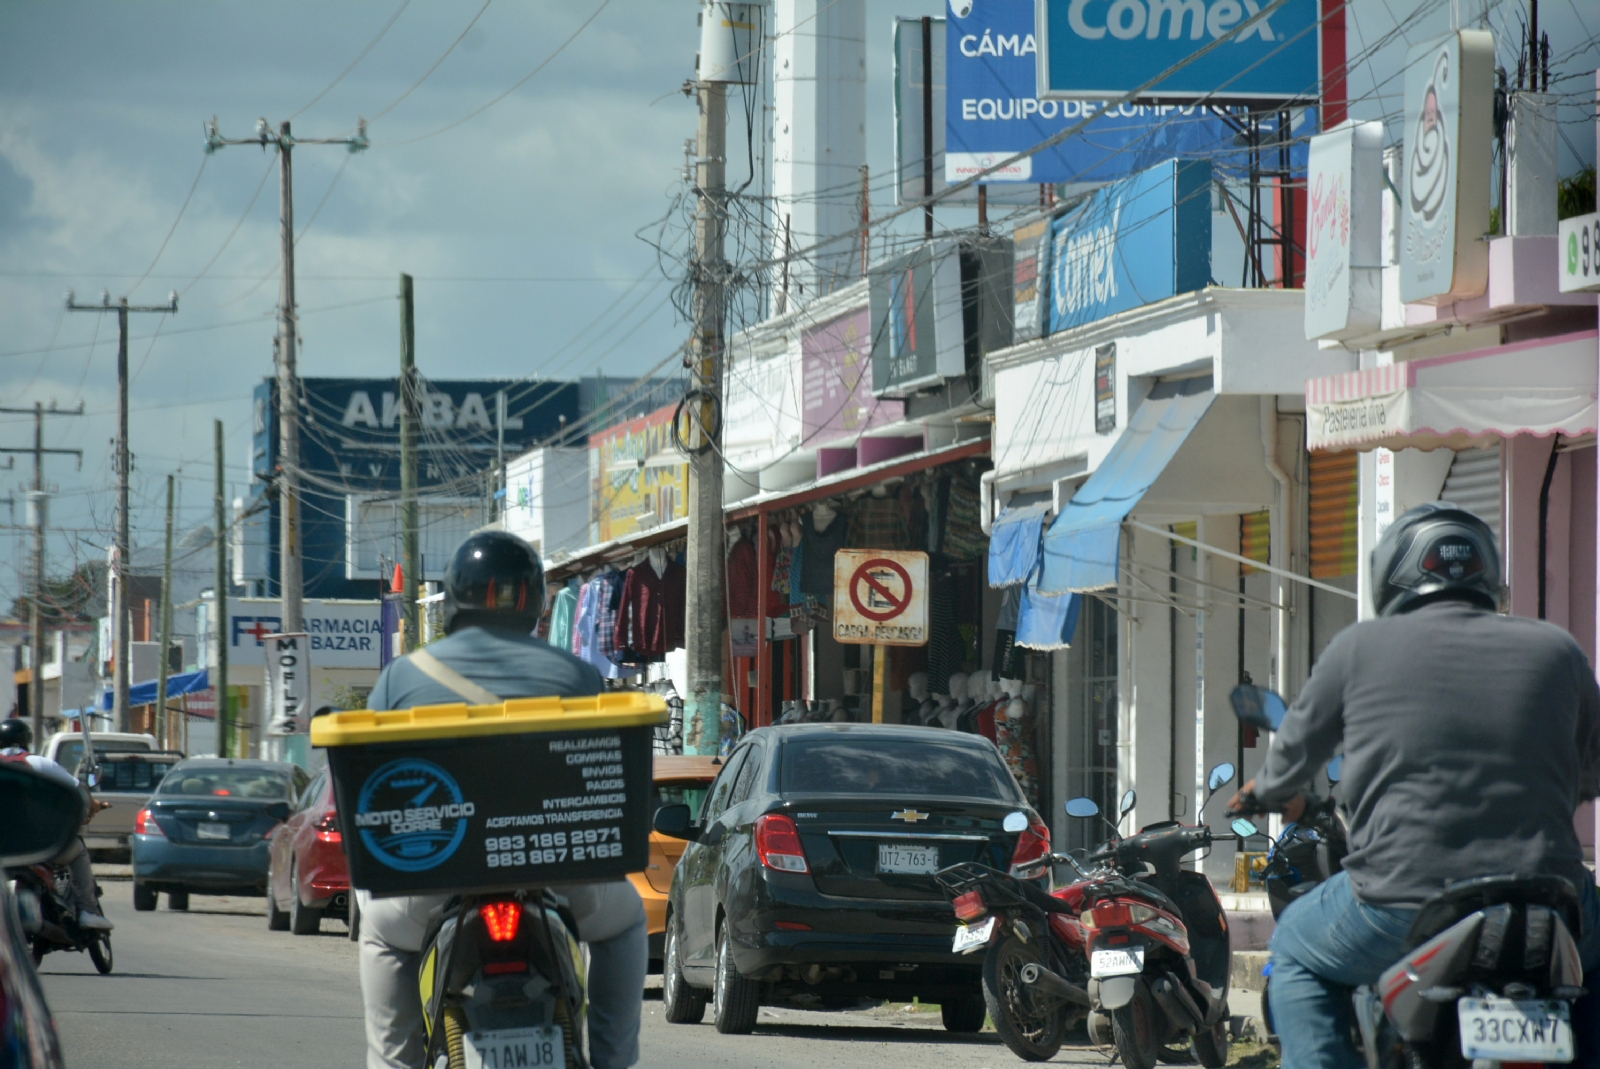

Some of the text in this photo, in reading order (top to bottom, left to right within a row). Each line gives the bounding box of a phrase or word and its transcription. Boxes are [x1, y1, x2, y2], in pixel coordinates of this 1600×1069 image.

[1067, 0, 1276, 43] Comex
[959, 28, 1037, 57] CÁMA
[962, 98, 1058, 120] EQUIPO
[1063, 100, 1097, 119] DE
[1055, 195, 1121, 316] Comex
[1582, 218, 1600, 277] 98
[301, 618, 382, 634] ARMACIA
[549, 736, 621, 752] REALIZAMOS
[566, 751, 622, 765] COMPRAS
[582, 764, 624, 778] ENVIOS
[586, 779, 626, 791] PAGOS
[542, 793, 626, 810] INTERCAMBIOS
[355, 802, 475, 826] MOTO SERVICIO
[486, 808, 624, 828] ACEPTAMOS TRANSFERENCIA
[390, 818, 441, 834] CORRE
[485, 827, 621, 851] 983 186 2971
[487, 842, 623, 867] 983 867 2162
[1472, 1017, 1558, 1043] 33CXW7
